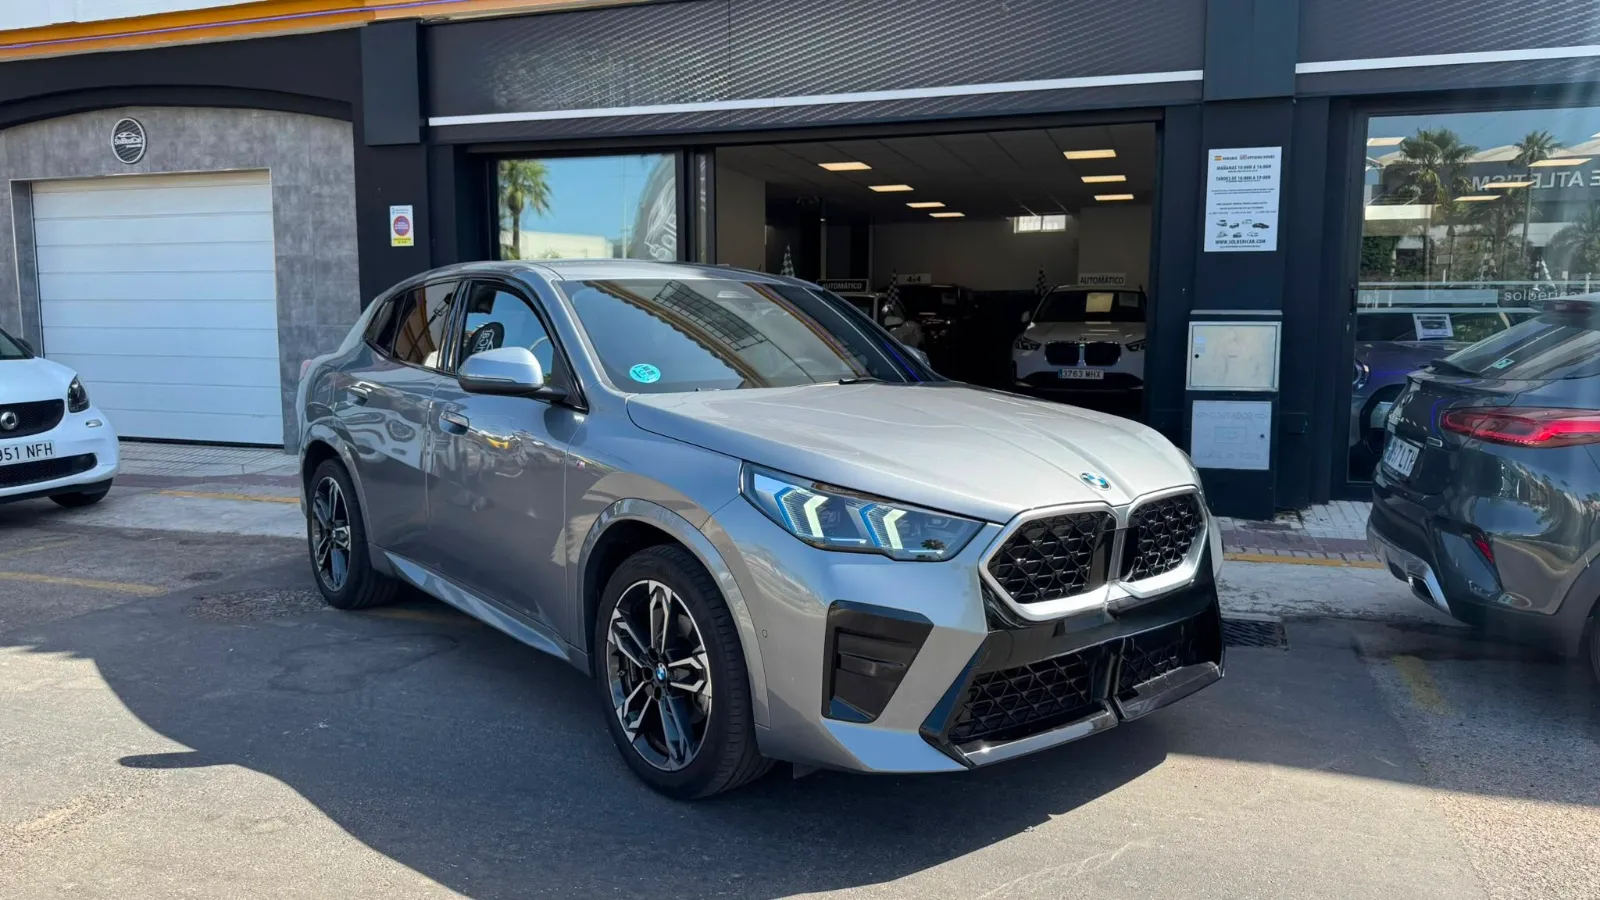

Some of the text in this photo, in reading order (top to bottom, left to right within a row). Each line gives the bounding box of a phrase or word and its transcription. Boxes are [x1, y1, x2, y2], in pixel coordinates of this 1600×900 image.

[1063, 370, 1101, 378] 3763 MHX
[26, 442, 53, 458] NFH
